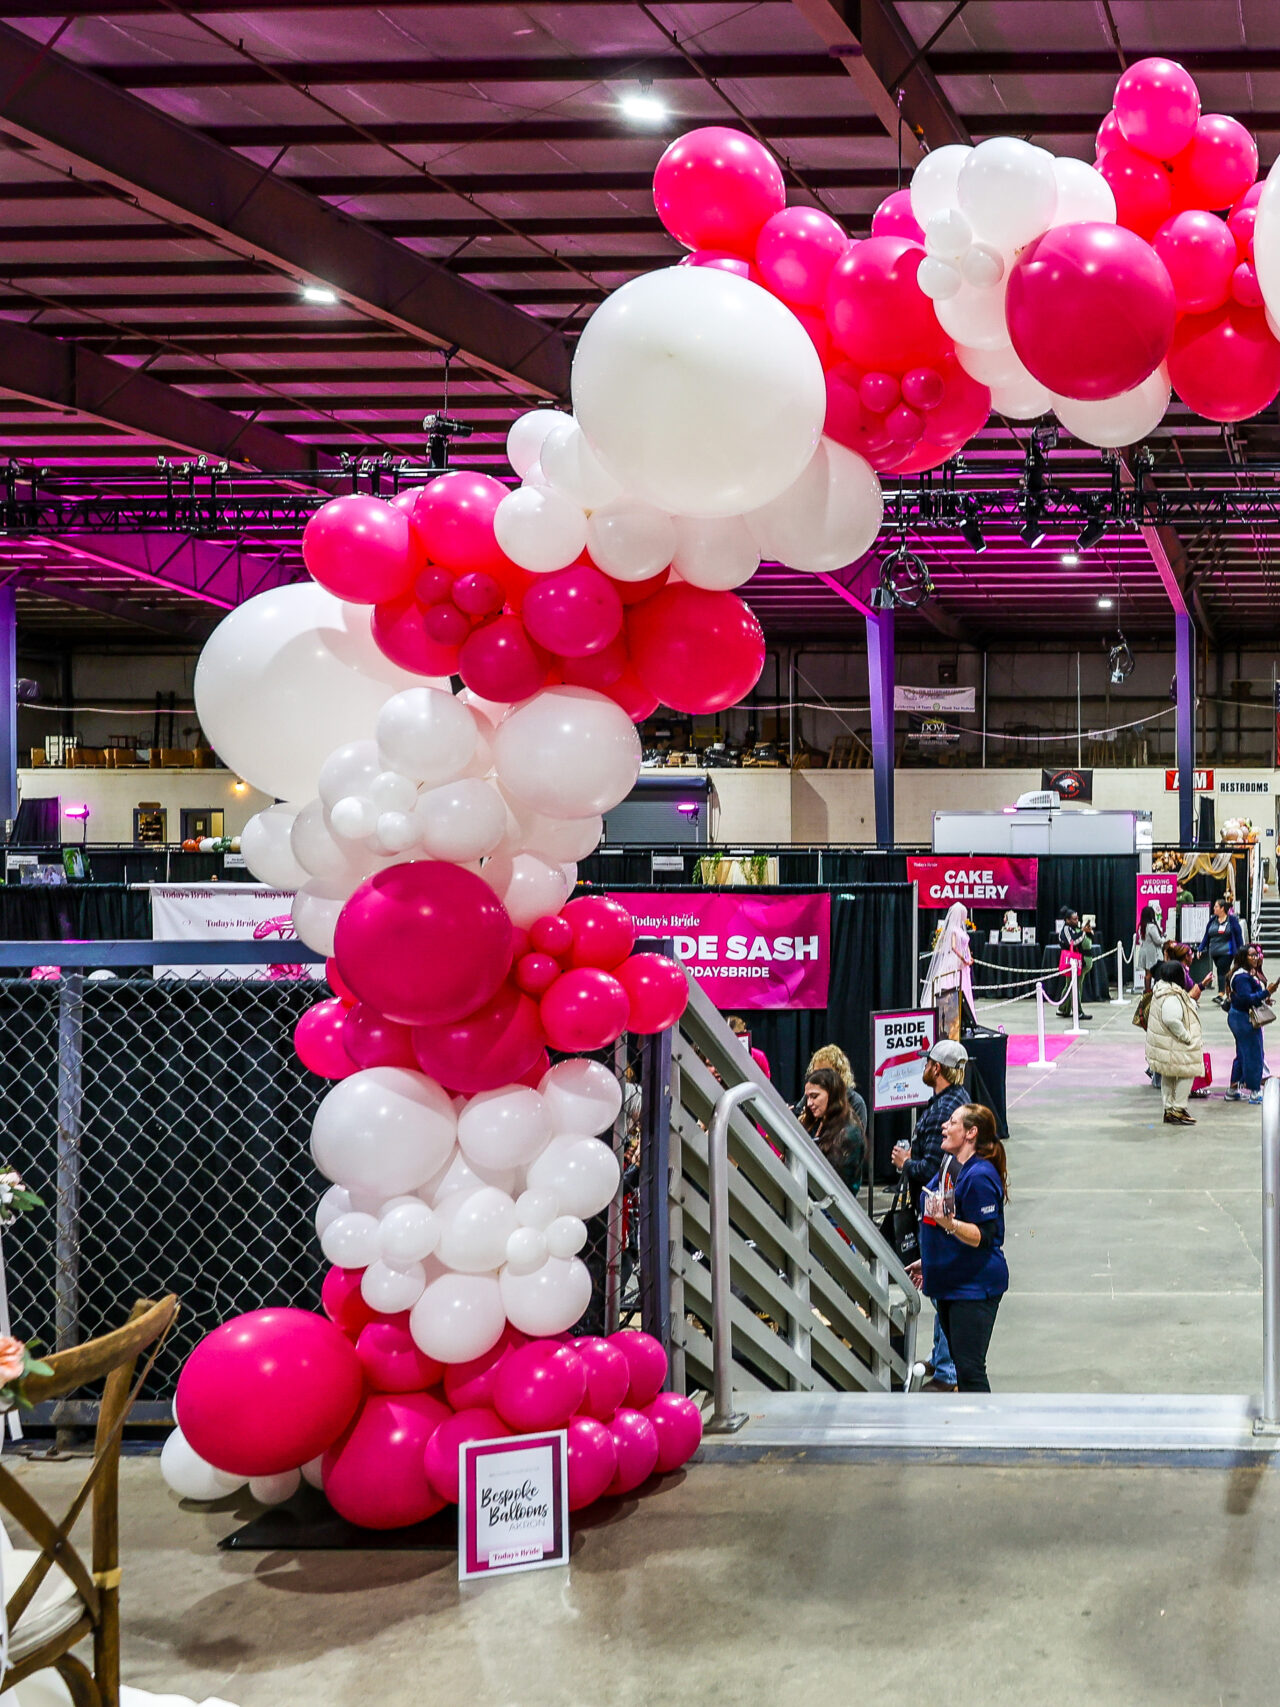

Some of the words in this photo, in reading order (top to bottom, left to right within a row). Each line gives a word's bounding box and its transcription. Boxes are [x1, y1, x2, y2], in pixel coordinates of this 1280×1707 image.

[1172, 771, 1208, 789] AM
[1220, 782, 1269, 793] RESTROOMS
[944, 870, 994, 884] CAKE
[161, 890, 190, 900] Today's
[191, 890, 213, 899] Bride
[253, 890, 281, 900] Today's
[929, 885, 1009, 899] GALLERY
[1140, 885, 1173, 894] CAKES
[205, 918, 235, 929] Today's
[236, 918, 259, 928] Bride
[630, 914, 668, 929] Today's
[670, 913, 700, 929] Bride
[725, 934, 819, 961] SASH
[686, 966, 770, 978] ODAYSBRIDE
[884, 1021, 925, 1036] BRIDE
[886, 1035, 923, 1049] SASH
[480, 1479, 539, 1509] Bespoke
[488, 1501, 549, 1527] Balloons
[492, 1549, 519, 1561] Today's
[520, 1547, 541, 1557] Bride
